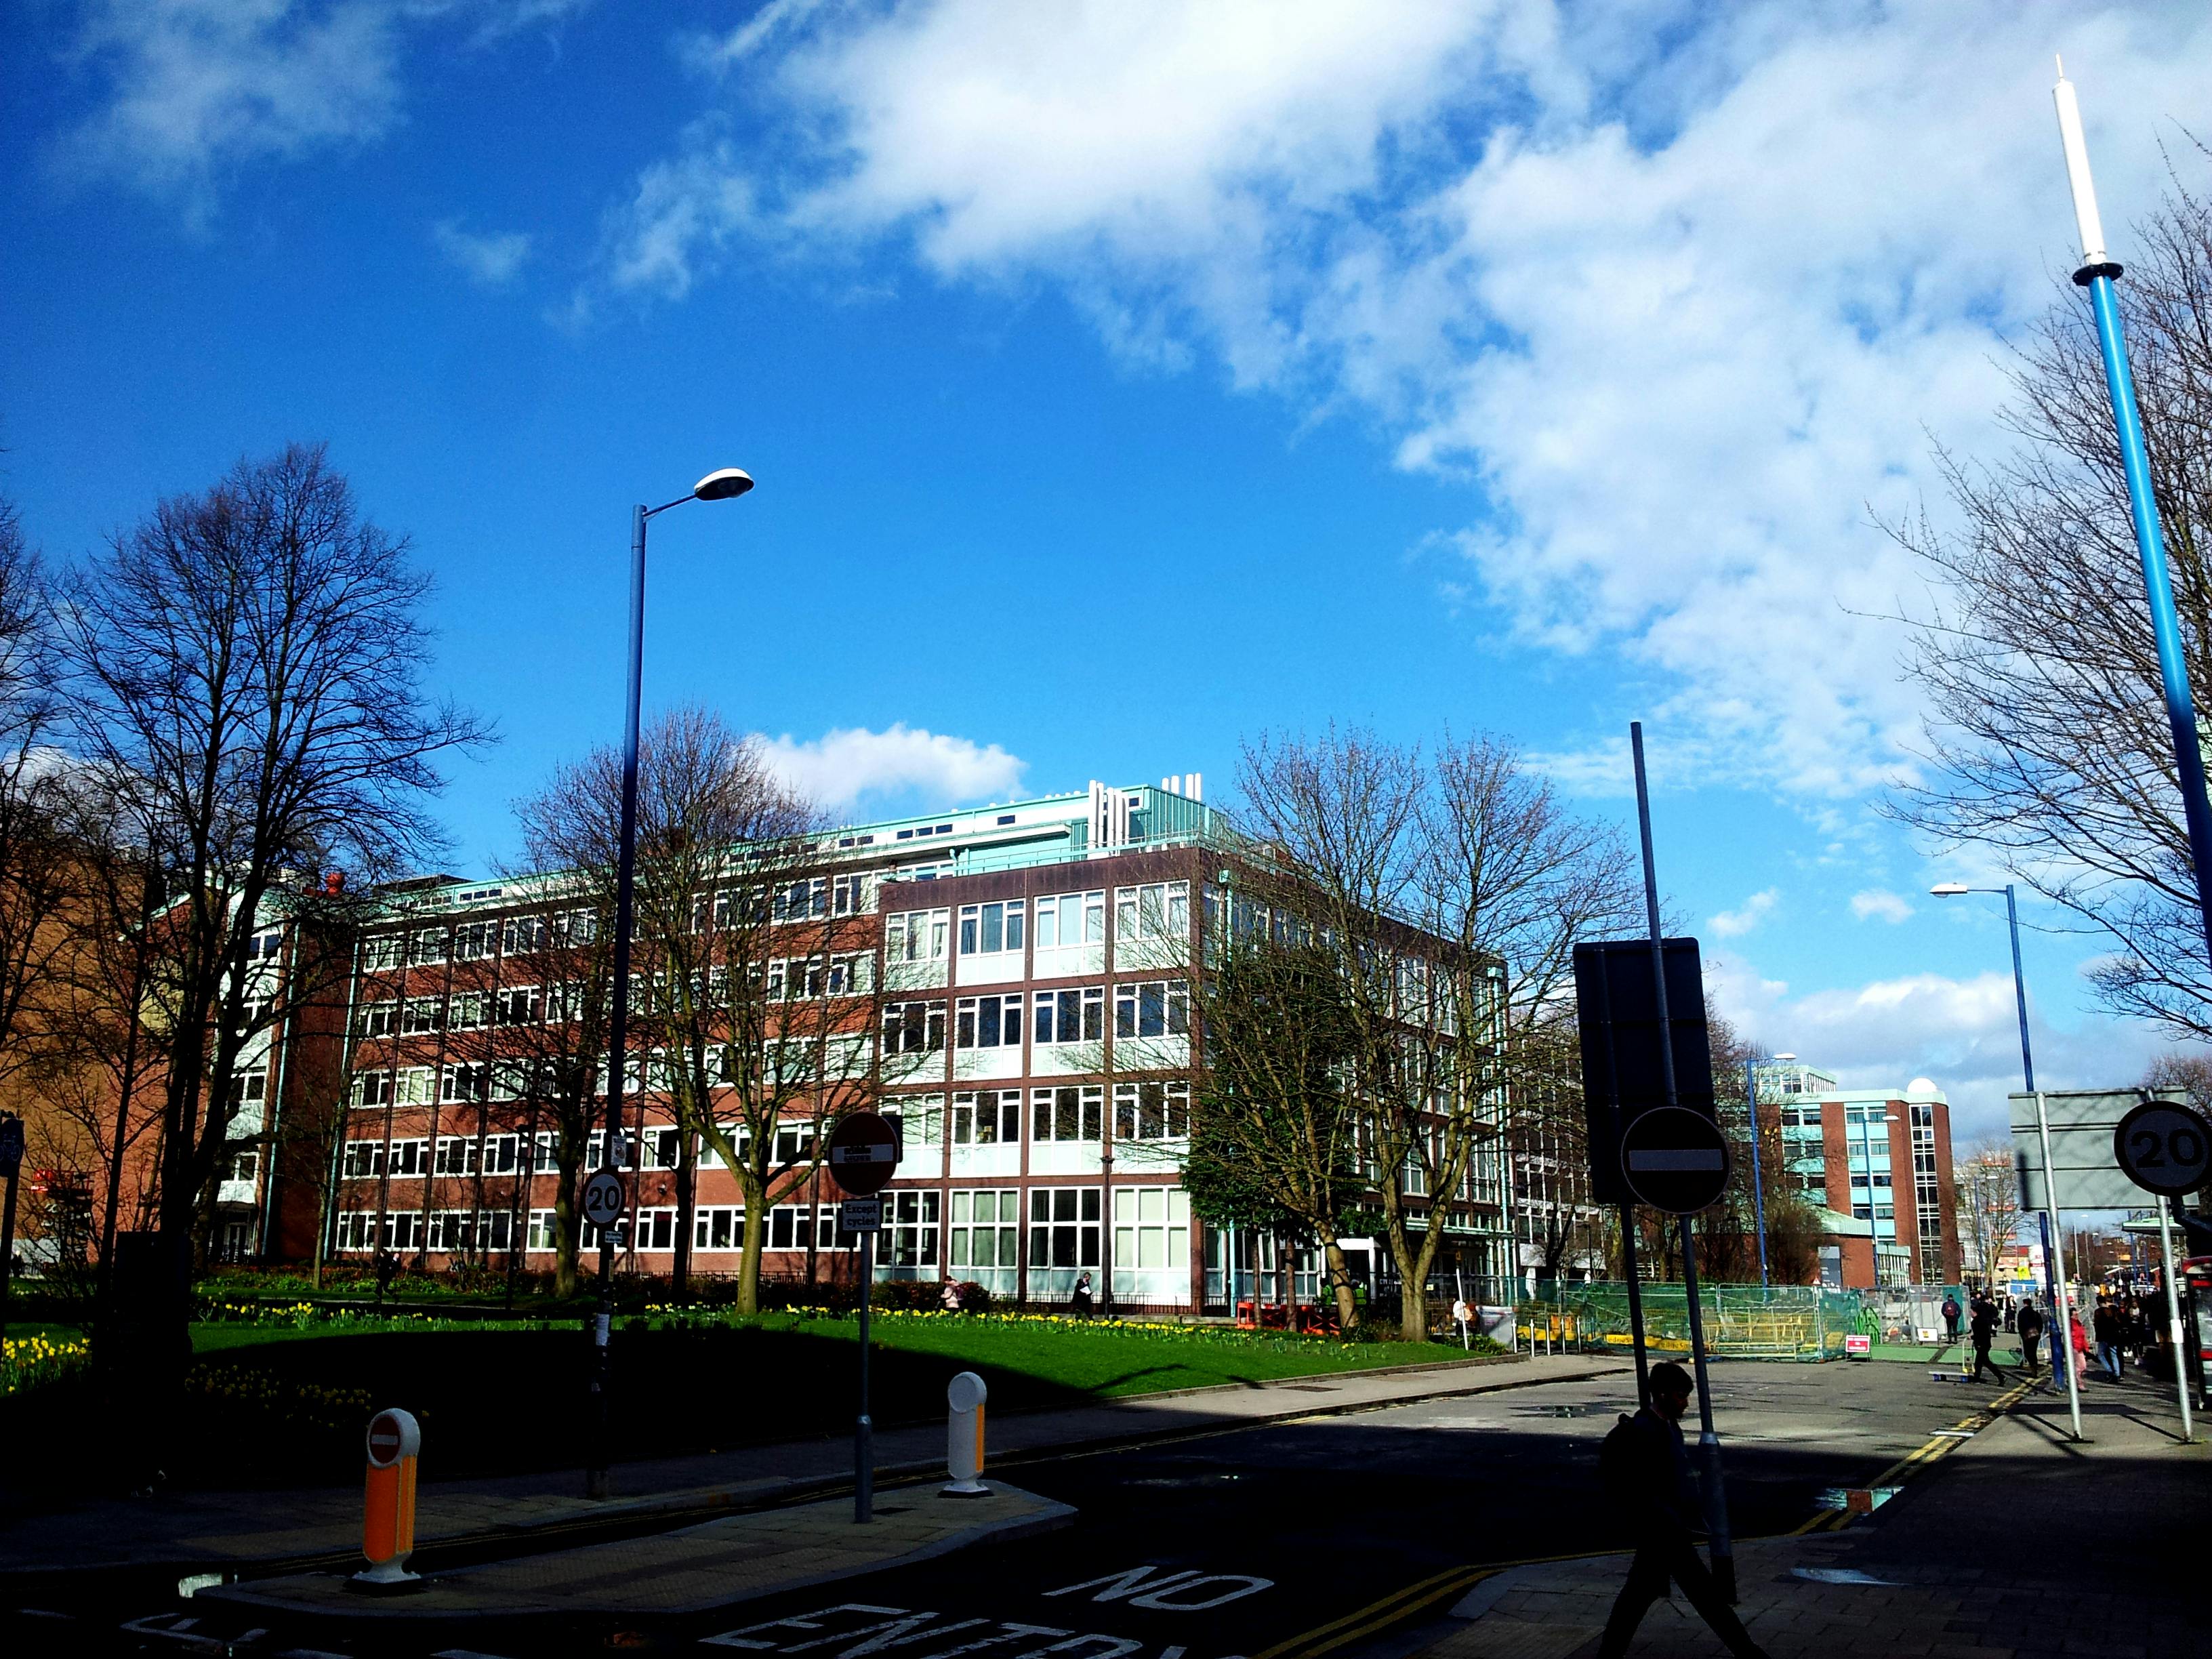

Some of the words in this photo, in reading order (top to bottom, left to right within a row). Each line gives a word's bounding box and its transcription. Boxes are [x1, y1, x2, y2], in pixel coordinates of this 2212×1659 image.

[2131, 1128, 2203, 1168] 20
[588, 1185, 620, 1211] 20
[845, 1204, 877, 1216] Except
[846, 1216, 876, 1228] cycles
[1041, 1565, 1275, 1611] NO
[697, 1603, 1254, 1659] ENTR
